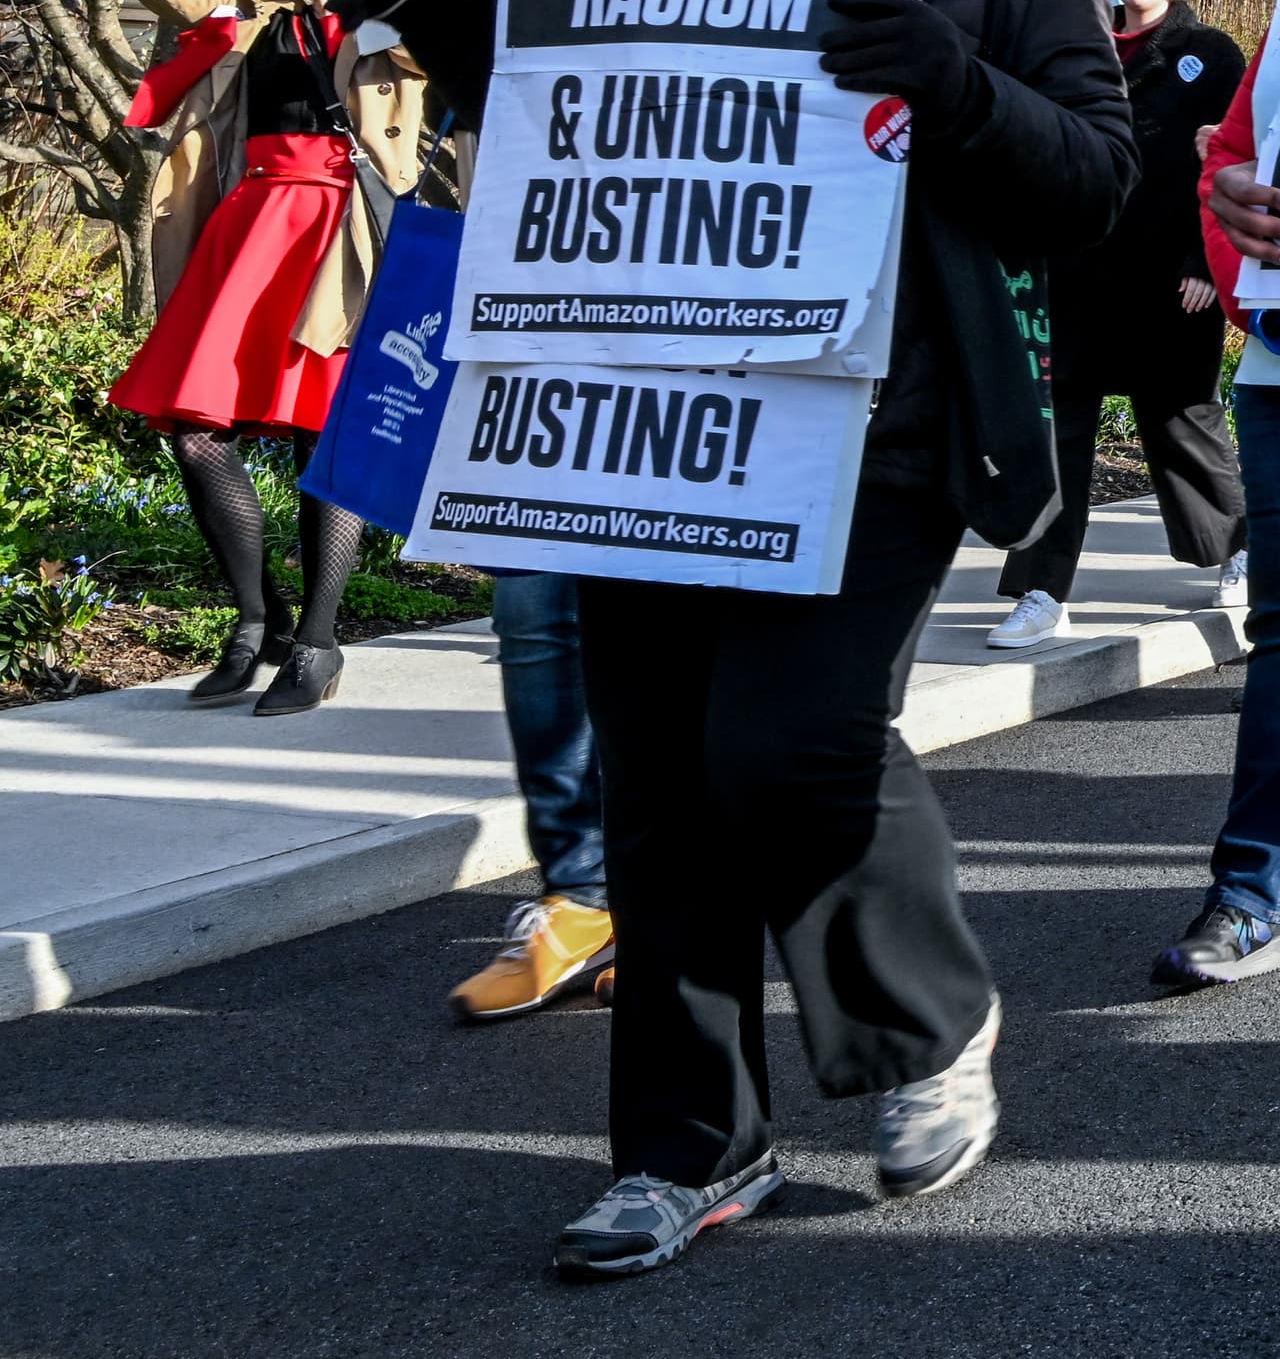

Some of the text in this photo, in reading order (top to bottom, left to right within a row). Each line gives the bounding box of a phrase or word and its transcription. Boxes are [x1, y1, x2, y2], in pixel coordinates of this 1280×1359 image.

[548, 74, 802, 166] & UNION
[513, 176, 812, 270] BUSTING!
[476, 295, 840, 332] SupportAmazonWorkers.org
[468, 375, 763, 486] BUSTING!
[435, 494, 792, 560] SupportAmazonWorkers.org
